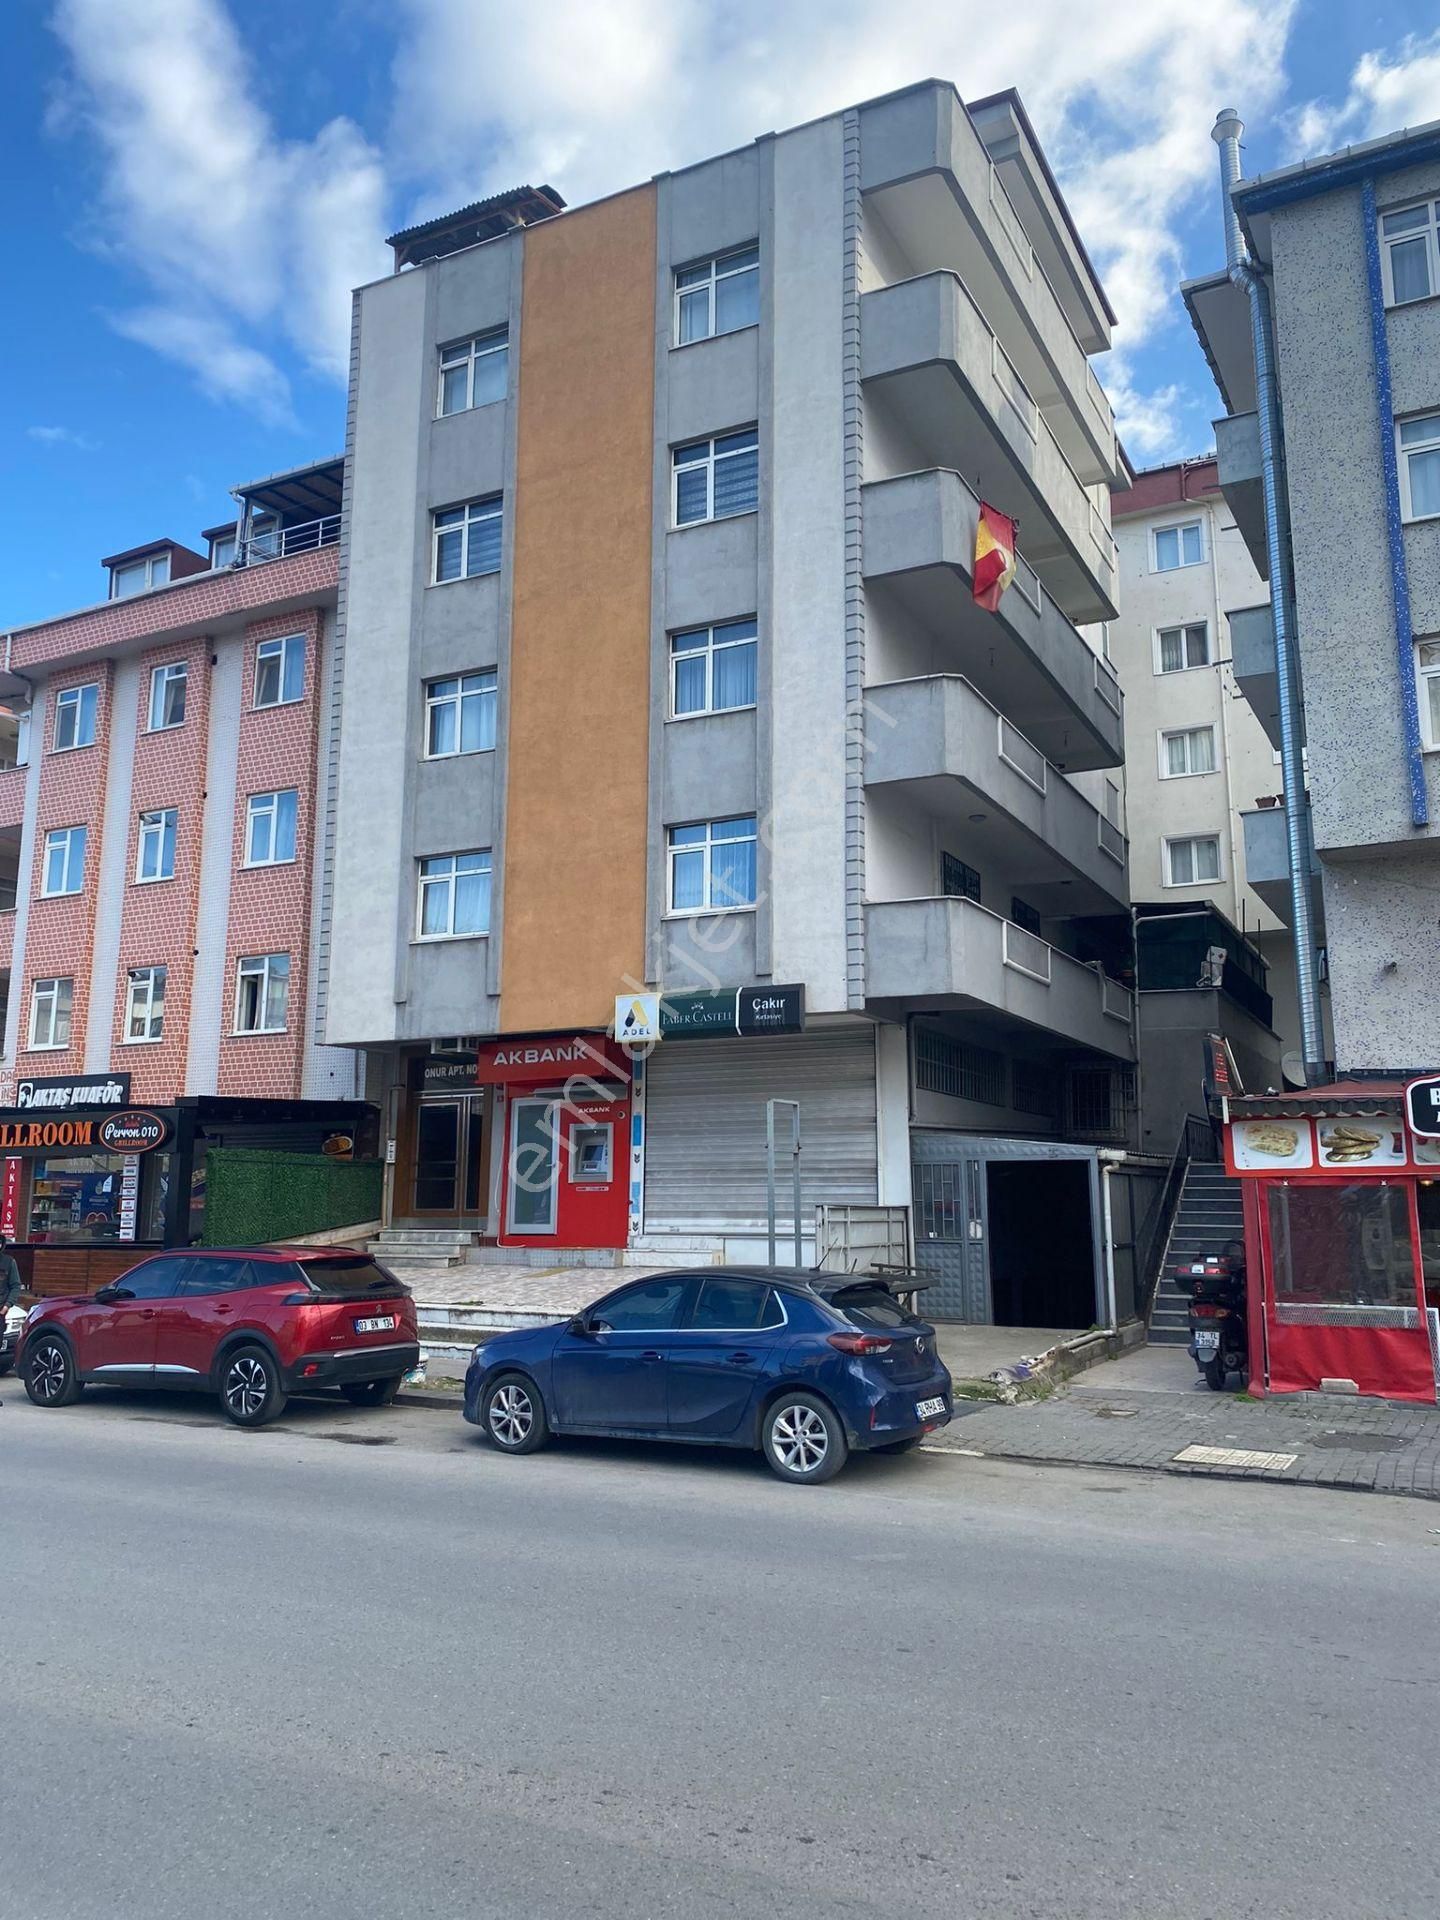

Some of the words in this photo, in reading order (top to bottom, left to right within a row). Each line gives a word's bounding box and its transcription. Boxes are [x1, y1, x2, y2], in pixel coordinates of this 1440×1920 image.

[752, 996, 786, 1012] Çakır
[622, 1029, 652, 1037] ADEL
[493, 1046, 588, 1066] AKBANK
[424, 1067, 446, 1079] ONUR
[448, 1065, 465, 1077] APT.
[32, 1087, 72, 1109] AKTAŞ
[70, 1081, 123, 1105] KUAFÖR
[577, 1106, 610, 1114] AKBANK
[0, 1121, 93, 1147] LLROOM
[105, 1122, 141, 1140] Perron
[141, 1126, 159, 1138] 010
[359, 1320, 367, 1331] 03
[383, 1317, 393, 1327] 134
